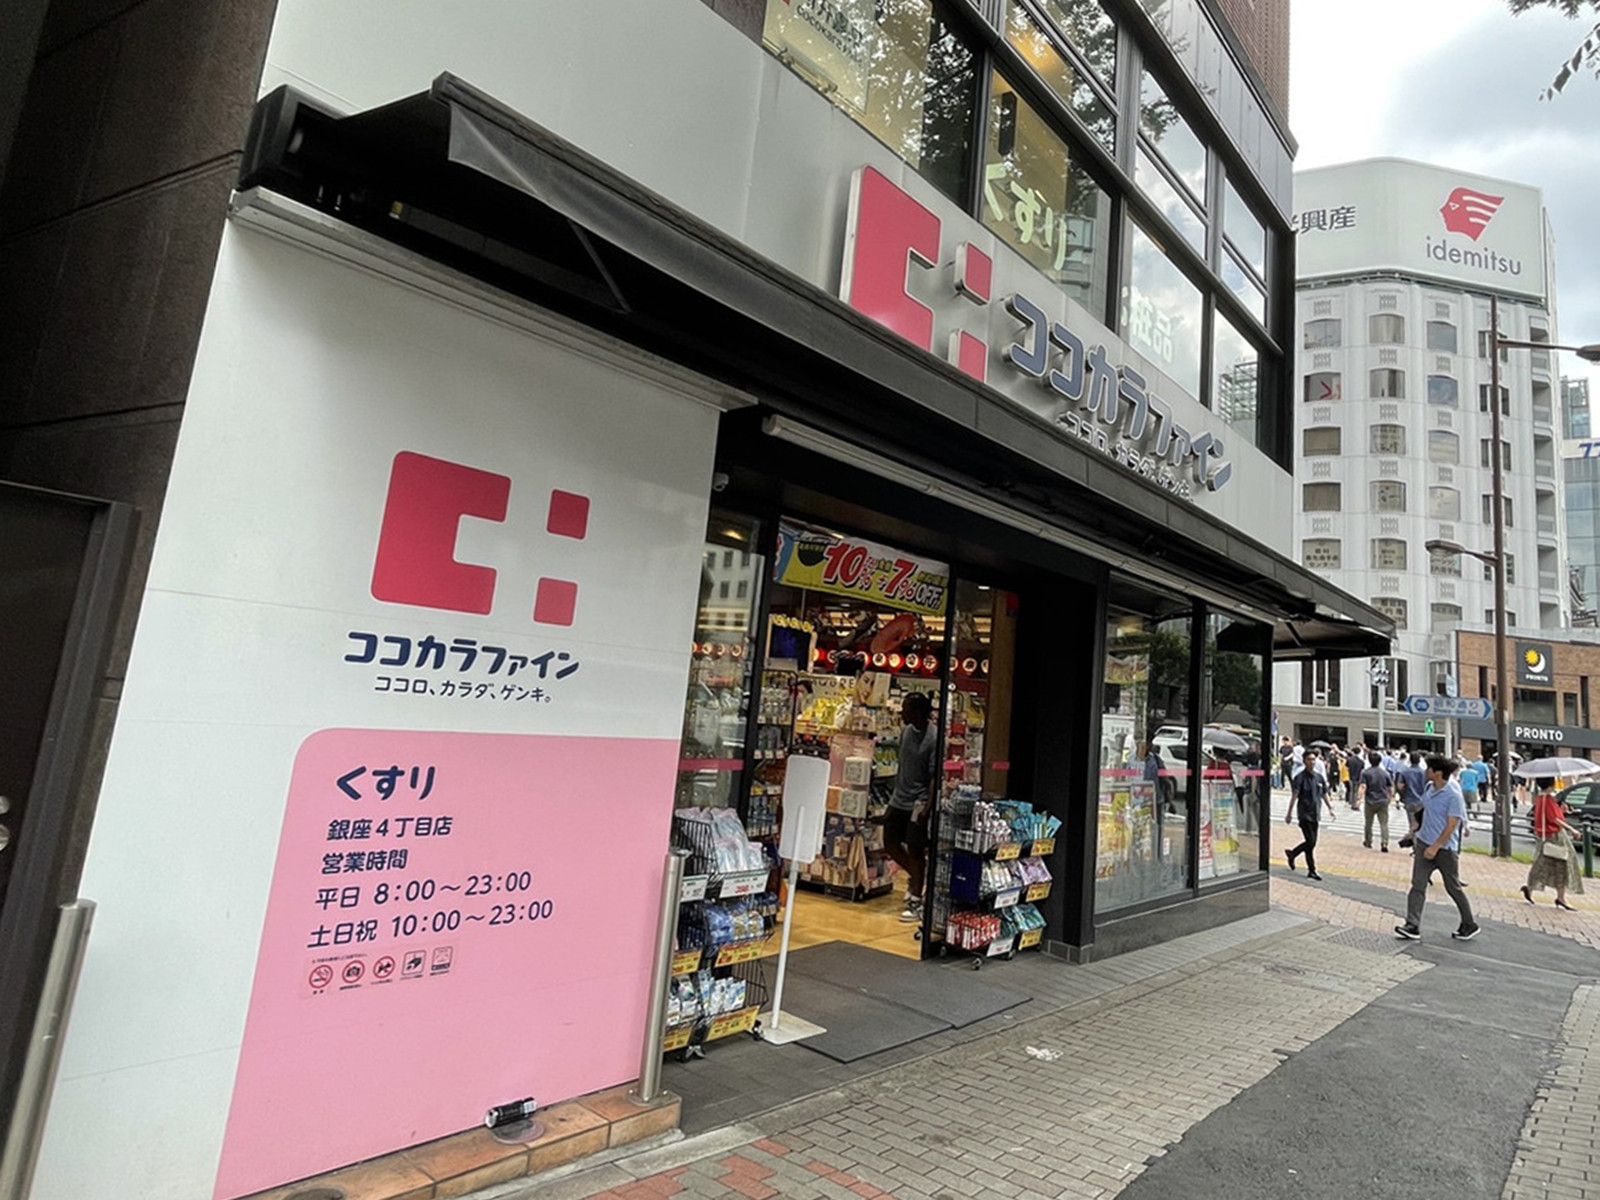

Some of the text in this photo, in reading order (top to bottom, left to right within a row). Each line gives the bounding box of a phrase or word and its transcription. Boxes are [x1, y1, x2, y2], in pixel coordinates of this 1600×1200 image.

[984, 163, 1067, 271] くすり
[1426, 236, 1521, 275] idemitsu
[1008, 293, 1232, 492] ココカラファイン
[344, 631, 580, 680] ココカラファイン
[374, 676, 552, 703] ココロ、カラダ、ゲンキ。
[1525, 673, 1549, 682] PRONTO
[1515, 726, 1564, 741] PRONTO
[336, 765, 436, 801] くすり
[326, 816, 453, 841] 銀座4丁目店
[321, 848, 408, 875] 営業時間
[315, 886, 360, 911] 平日
[307, 919, 378, 948] 土日祝
